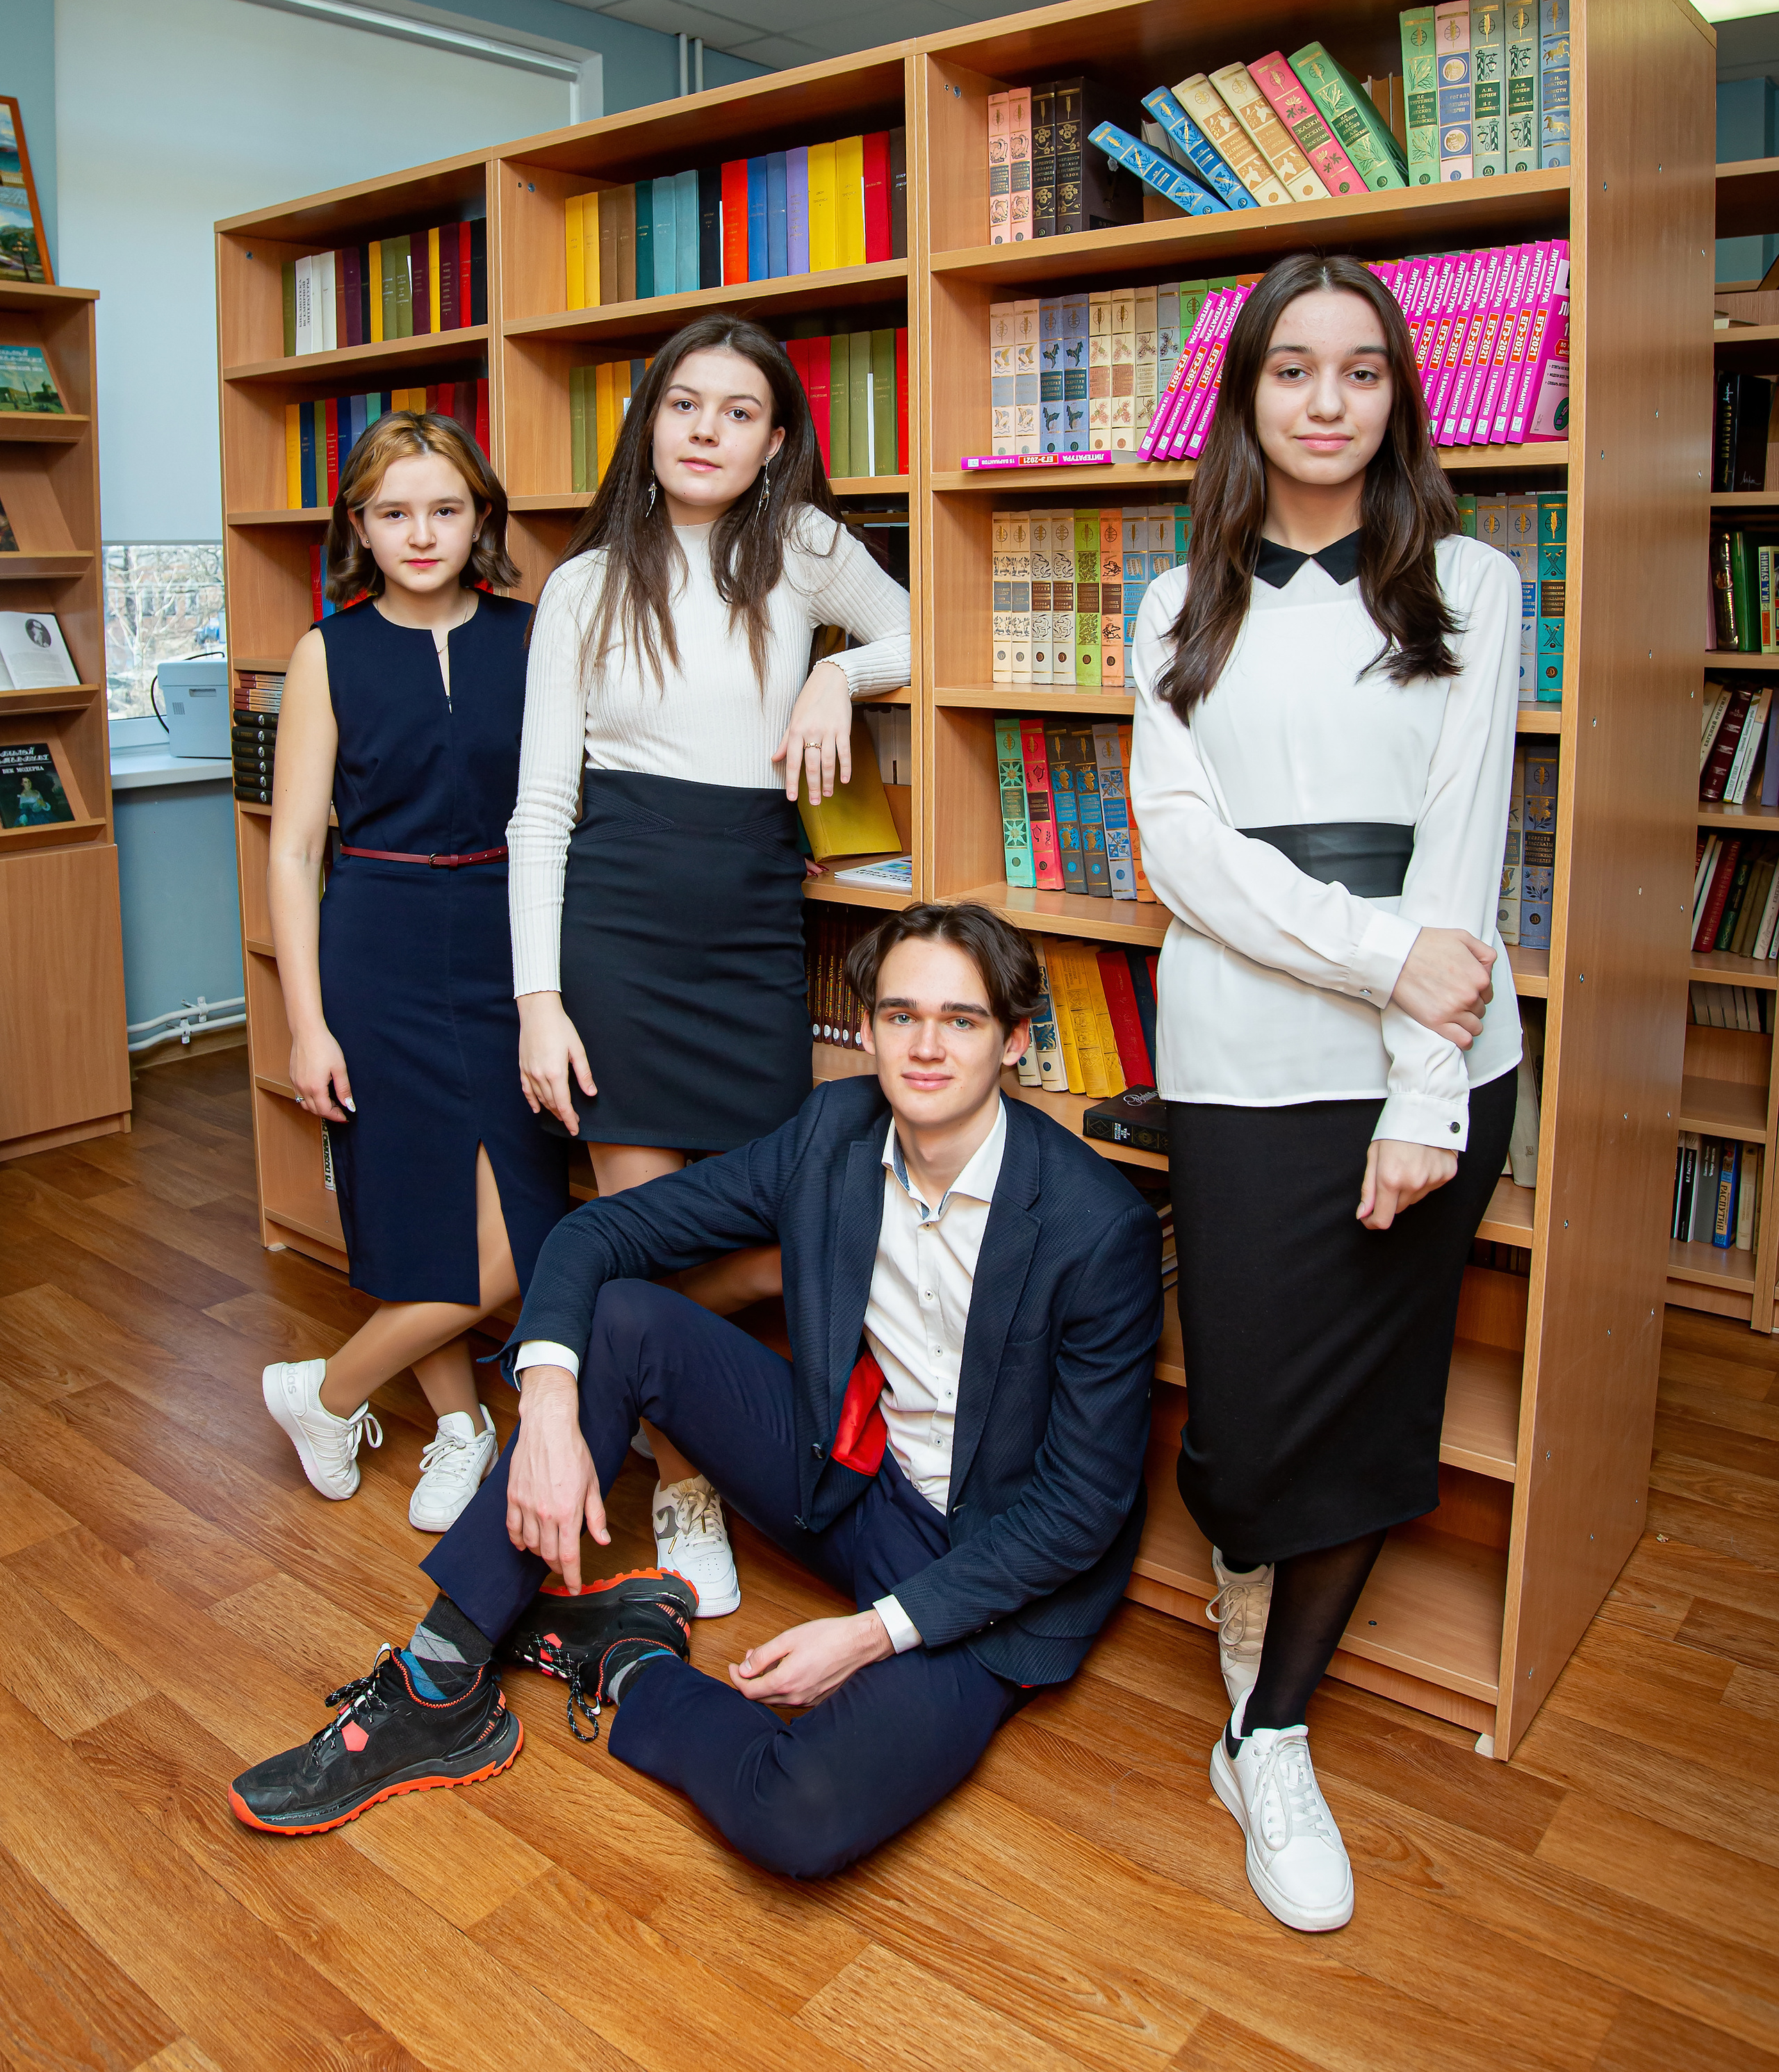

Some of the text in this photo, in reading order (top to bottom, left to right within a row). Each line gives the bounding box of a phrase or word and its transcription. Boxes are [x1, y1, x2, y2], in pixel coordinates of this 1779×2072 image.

[1295, 118, 1320, 134] СКАЗКИ
[1301, 125, 1325, 141] РУССКИХ
[1402, 268, 1419, 318] ЛИТЕРАТУР
[1415, 265, 1435, 316] ЛИТЕРАТУРА
[1431, 262, 1451, 314] ЛИТЕРАТУРА
[1446, 261, 1466, 313] ЛИТЕРАТУРА
[1461, 259, 1482, 311] ЛИТЕРАТУРА
[1478, 256, 1498, 309] ЛИТЕРАТУРА
[1493, 254, 1513, 307] ЛИТЕРАТУРА
[1509, 254, 1529, 308] ЛИТЕРАТУРА
[1525, 249, 1543, 303] ЛИТЕРАТУРА
[1541, 249, 1559, 303] ЛИТЕРАТУРА
[1188, 299, 1213, 344] ЛИТЕРАТУРА
[1204, 296, 1227, 342] ЛИТЕРАТУРА
[1219, 292, 1243, 339] ЛИТЕРАТУРА
[1416, 325, 1433, 364] ЕГЭ-2021
[1432, 325, 1448, 364] ЕГЭ-2021
[1448, 323, 1464, 362] ЕГЭ-2021
[1464, 320, 1481, 360] ЕГЭ-2021
[1480, 320, 1496, 359] ЕГЭ-2021
[1496, 320, 1513, 360] ЕГЭ-2021
[1513, 316, 1529, 356] ЕГЭ-2021
[1530, 316, 1544, 357] ЕГЭ-2021
[1169, 354, 1188, 388] ЕГЭ-2021
[1186, 352, 1204, 386] ЕГЭ-2021
[1201, 349, 1220, 384] ЕГЭ-2021
[1433, 381, 1447, 416] ВАРИАНТОВ
[1450, 380, 1464, 415] ВАРИАНТОВ
[1466, 379, 1479, 414] ВАРИАНТОВ
[1483, 380, 1496, 416] ВАРИАНТОВ
[1501, 376, 1514, 412] ВАРИАНТОВ
[1518, 376, 1530, 413] ВАРИАНТОВ
[1149, 403, 1166, 434] ВАРИАНТОВ
[1166, 403, 1183, 434] ВАРИАНТОВ
[1182, 400, 1198, 431] ВАРИАНТОВ
[1198, 400, 1214, 431] ВАРИАНТОВ
[1721, 405, 1732, 459] ПЛАТОНОВ
[1063, 453, 1105, 462] ЛИТЕРАТУРА
[1704, 696, 1727, 747] ЕВГЕНИЙ ОНЕГИН
[1716, 1184, 1728, 1231] РАСПУТИН
